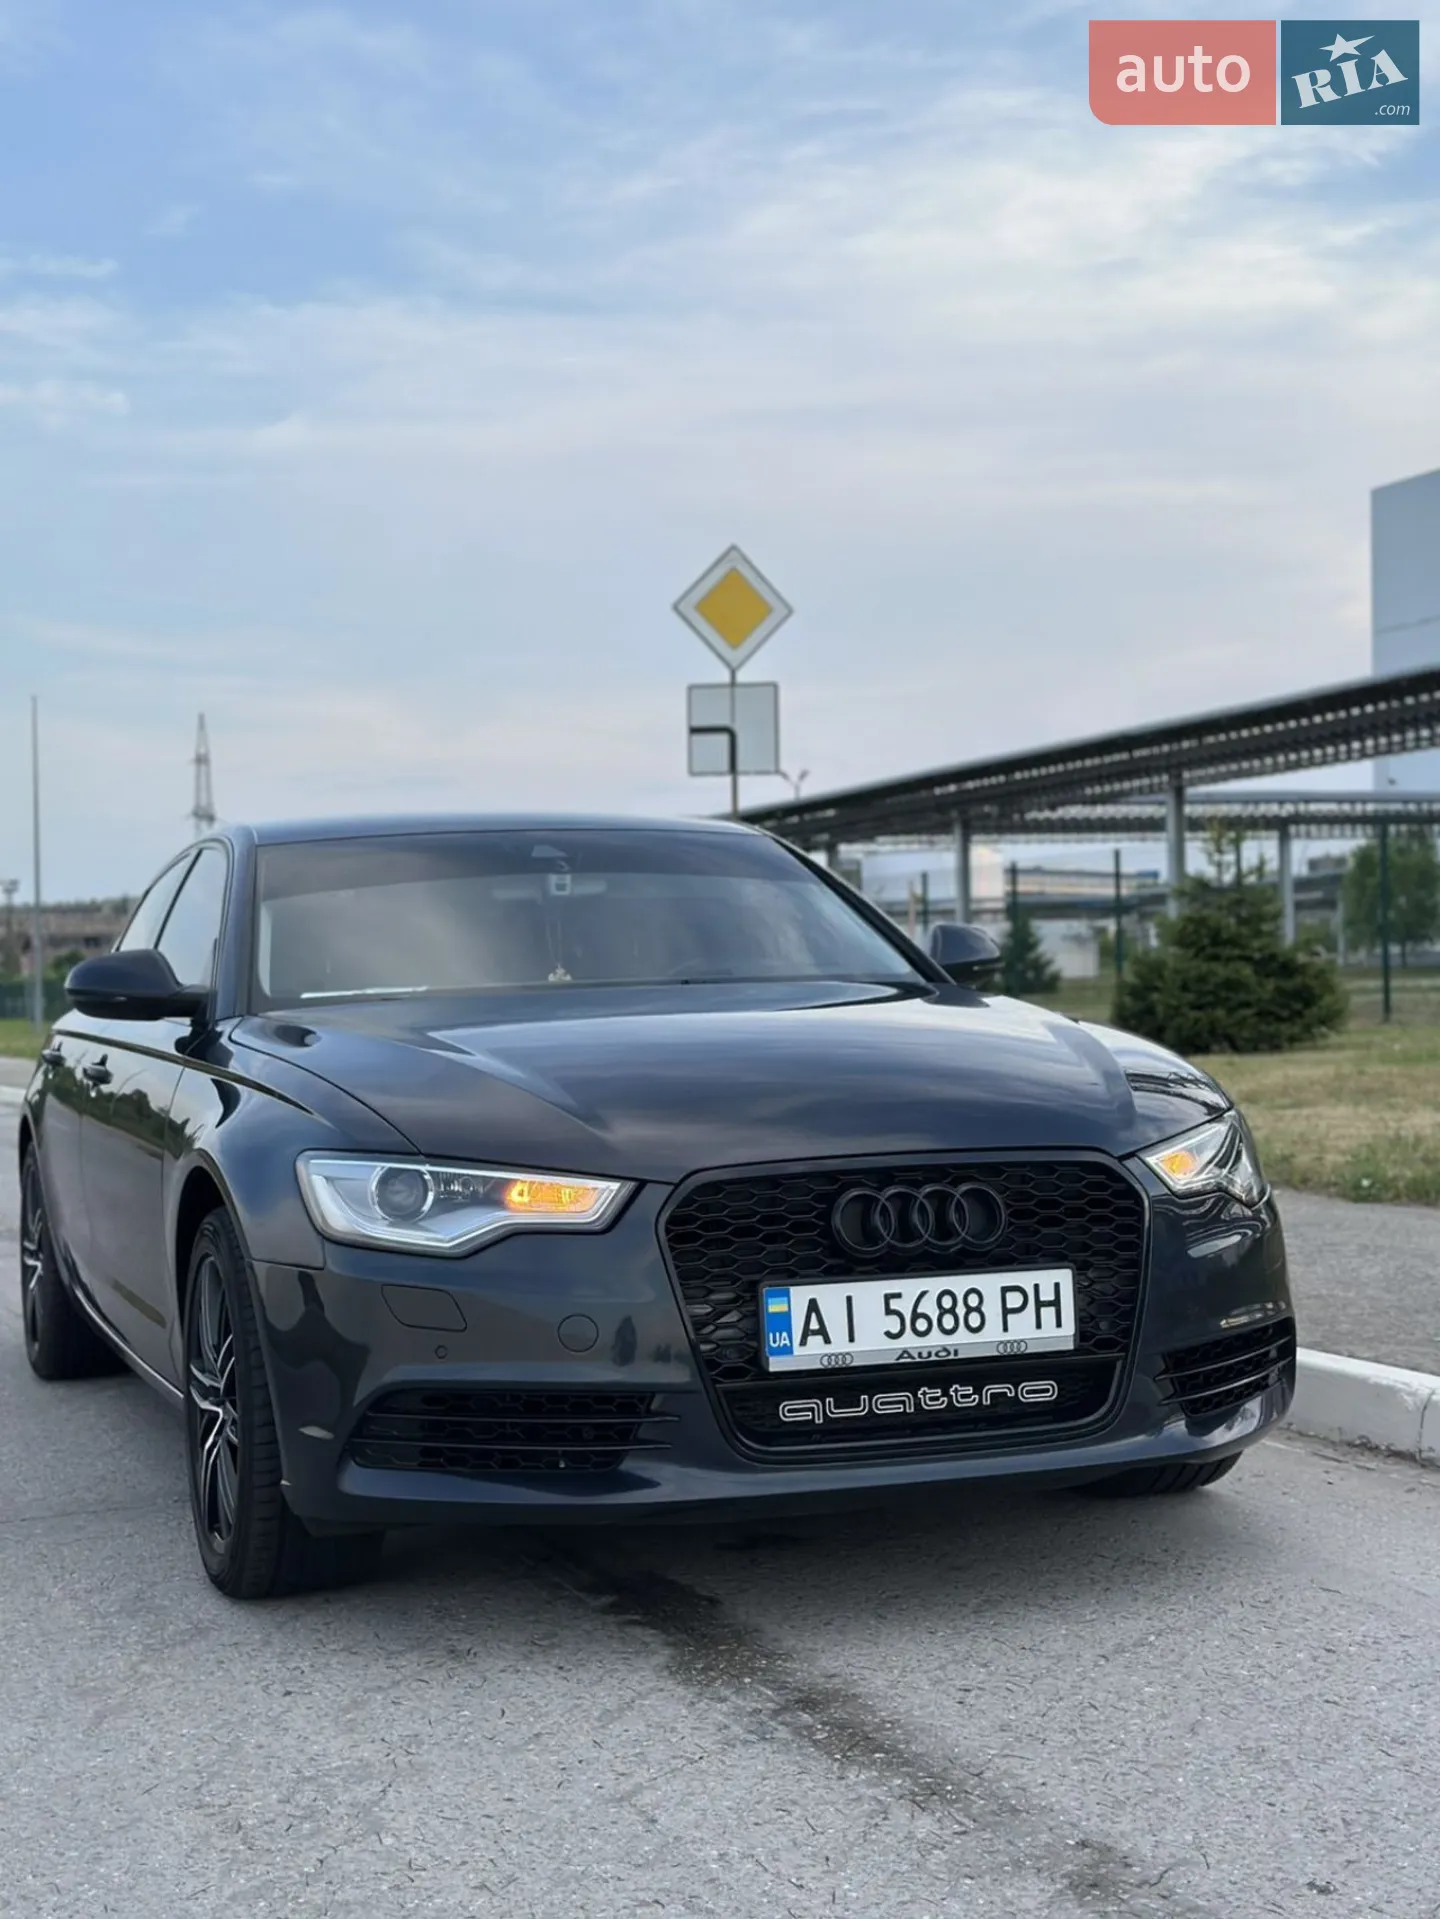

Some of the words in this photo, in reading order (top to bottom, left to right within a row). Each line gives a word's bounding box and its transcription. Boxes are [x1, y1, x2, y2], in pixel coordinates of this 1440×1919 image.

[799, 1295, 856, 1347] AI
[883, 1287, 986, 1340] 5688
[1000, 1282, 1062, 1333] PH
[769, 1332, 791, 1348] UA
[894, 1346, 959, 1362] Audi
[779, 1380, 1058, 1424] quattro
